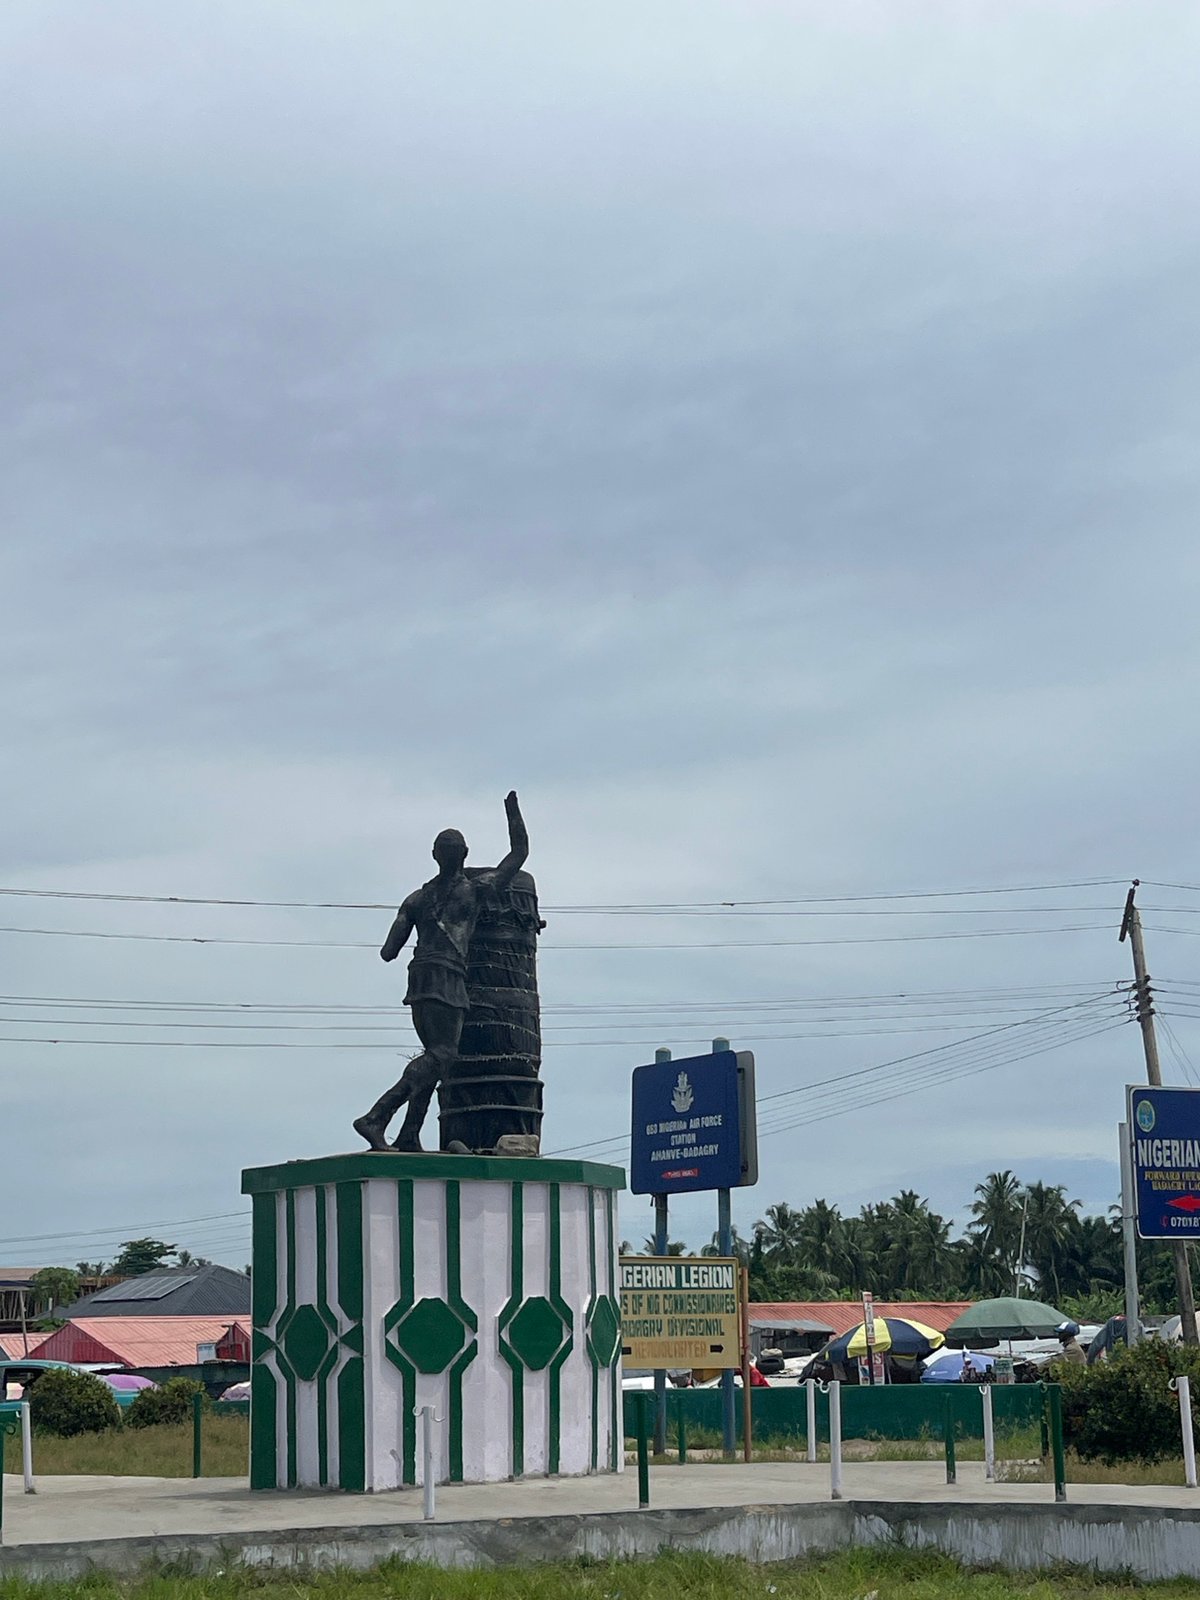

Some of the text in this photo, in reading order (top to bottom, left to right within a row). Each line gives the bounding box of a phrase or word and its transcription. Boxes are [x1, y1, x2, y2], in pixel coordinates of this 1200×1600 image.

[689, 1118, 700, 1129] AIR
[701, 1115, 722, 1127] FORCE
[671, 1133, 696, 1146] STATION
[681, 1266, 733, 1288] LEGION
[632, 1294, 643, 1315] OF
